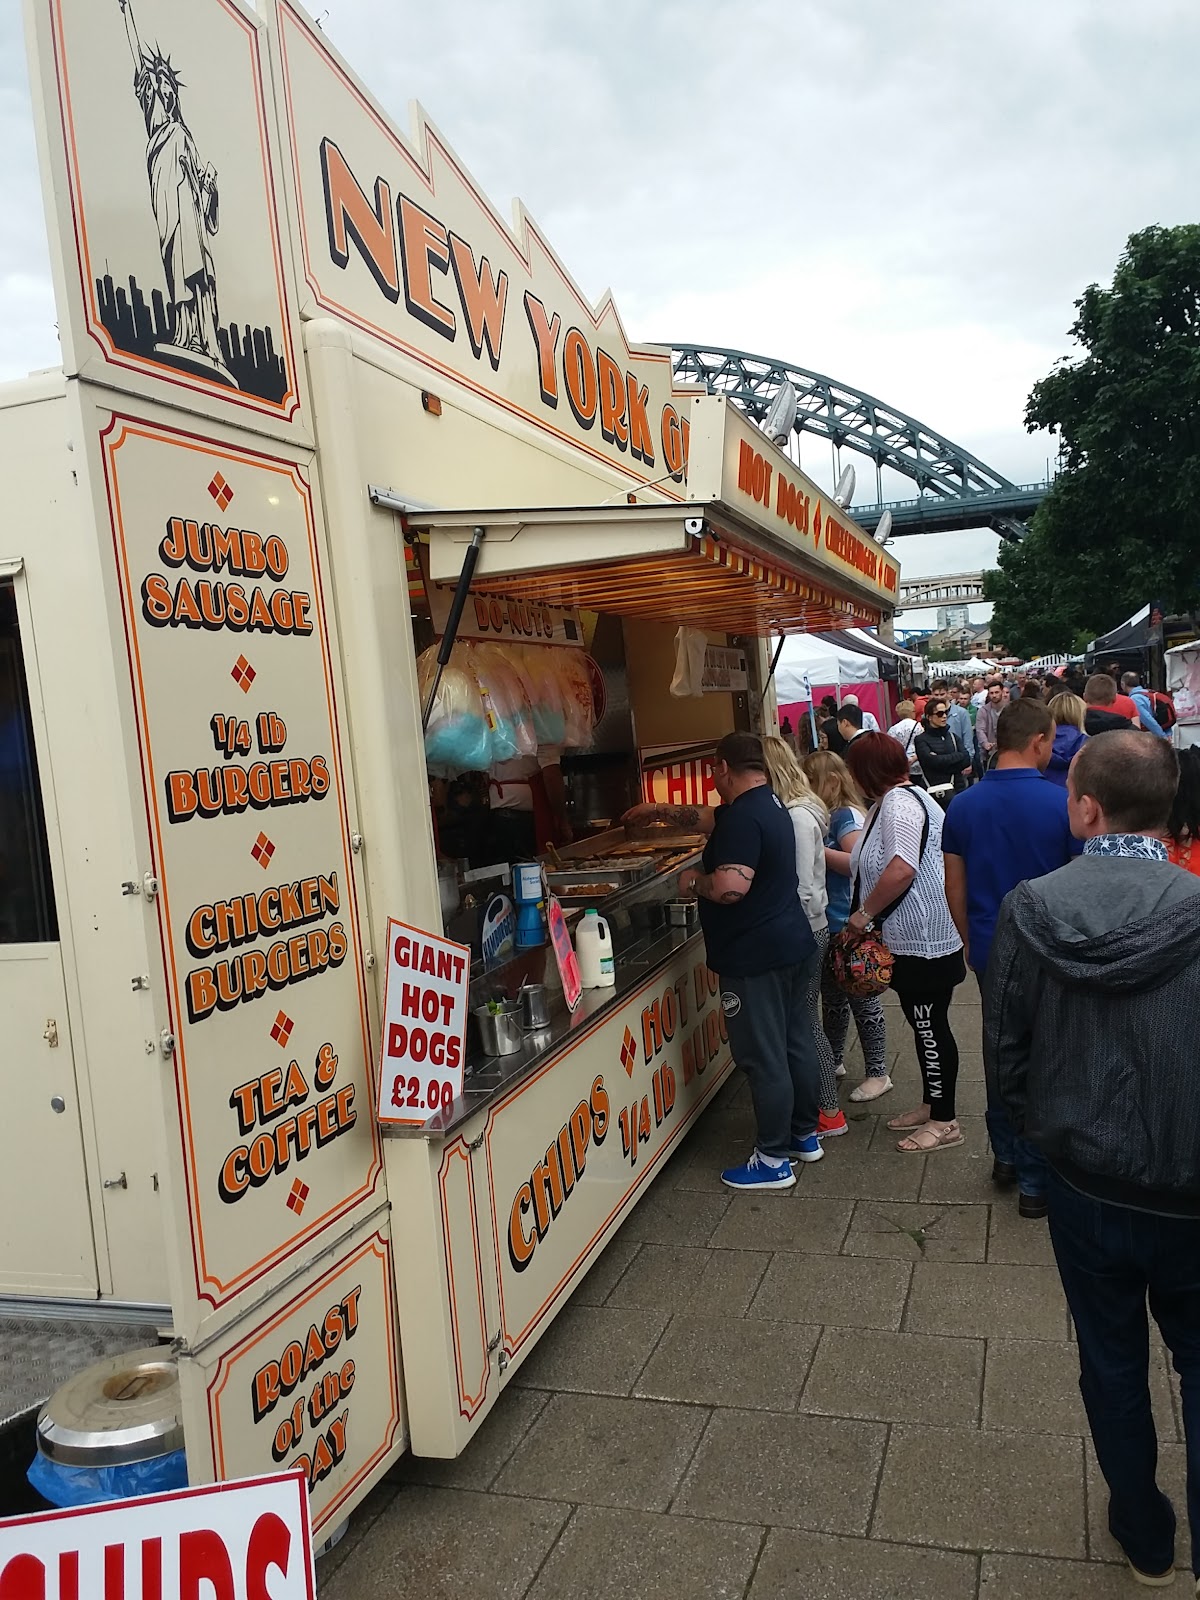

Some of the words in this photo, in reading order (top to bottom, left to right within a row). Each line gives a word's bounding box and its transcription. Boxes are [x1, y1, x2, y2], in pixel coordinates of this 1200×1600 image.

[319, 136, 509, 372] NEW
[524, 289, 655, 468] YORK
[738, 438, 773, 509] HOT
[776, 472, 810, 536] DOGS
[159, 516, 289, 582] JUMBO
[141, 573, 313, 636] SAUSAGE
[474, 597, 553, 639] DO-NUTS
[210, 713, 252, 760] 1/4
[165, 755, 330, 824] BURGERS
[646, 757, 726, 806] CHIP
[185, 871, 340, 959] CHICKEN
[185, 922, 347, 1024] BURGERS
[394, 935, 465, 984] GIANT
[401, 982, 455, 1027] HOT
[641, 972, 689, 1066] HOT
[913, 1003, 934, 1019] NY
[387, 1022, 461, 1069] DOGS
[916, 1019, 943, 1098] BROOKLYN
[229, 1060, 309, 1137] TEA
[314, 1042, 339, 1093] &
[391, 1074, 454, 1110] £2.00
[218, 1083, 357, 1204] COFFEE
[618, 1094, 651, 1167] 1/4
[508, 1074, 611, 1273] CHIPS
[251, 1285, 361, 1424] ROAST
[271, 1396, 305, 1463] of
[308, 1359, 356, 1428] the
